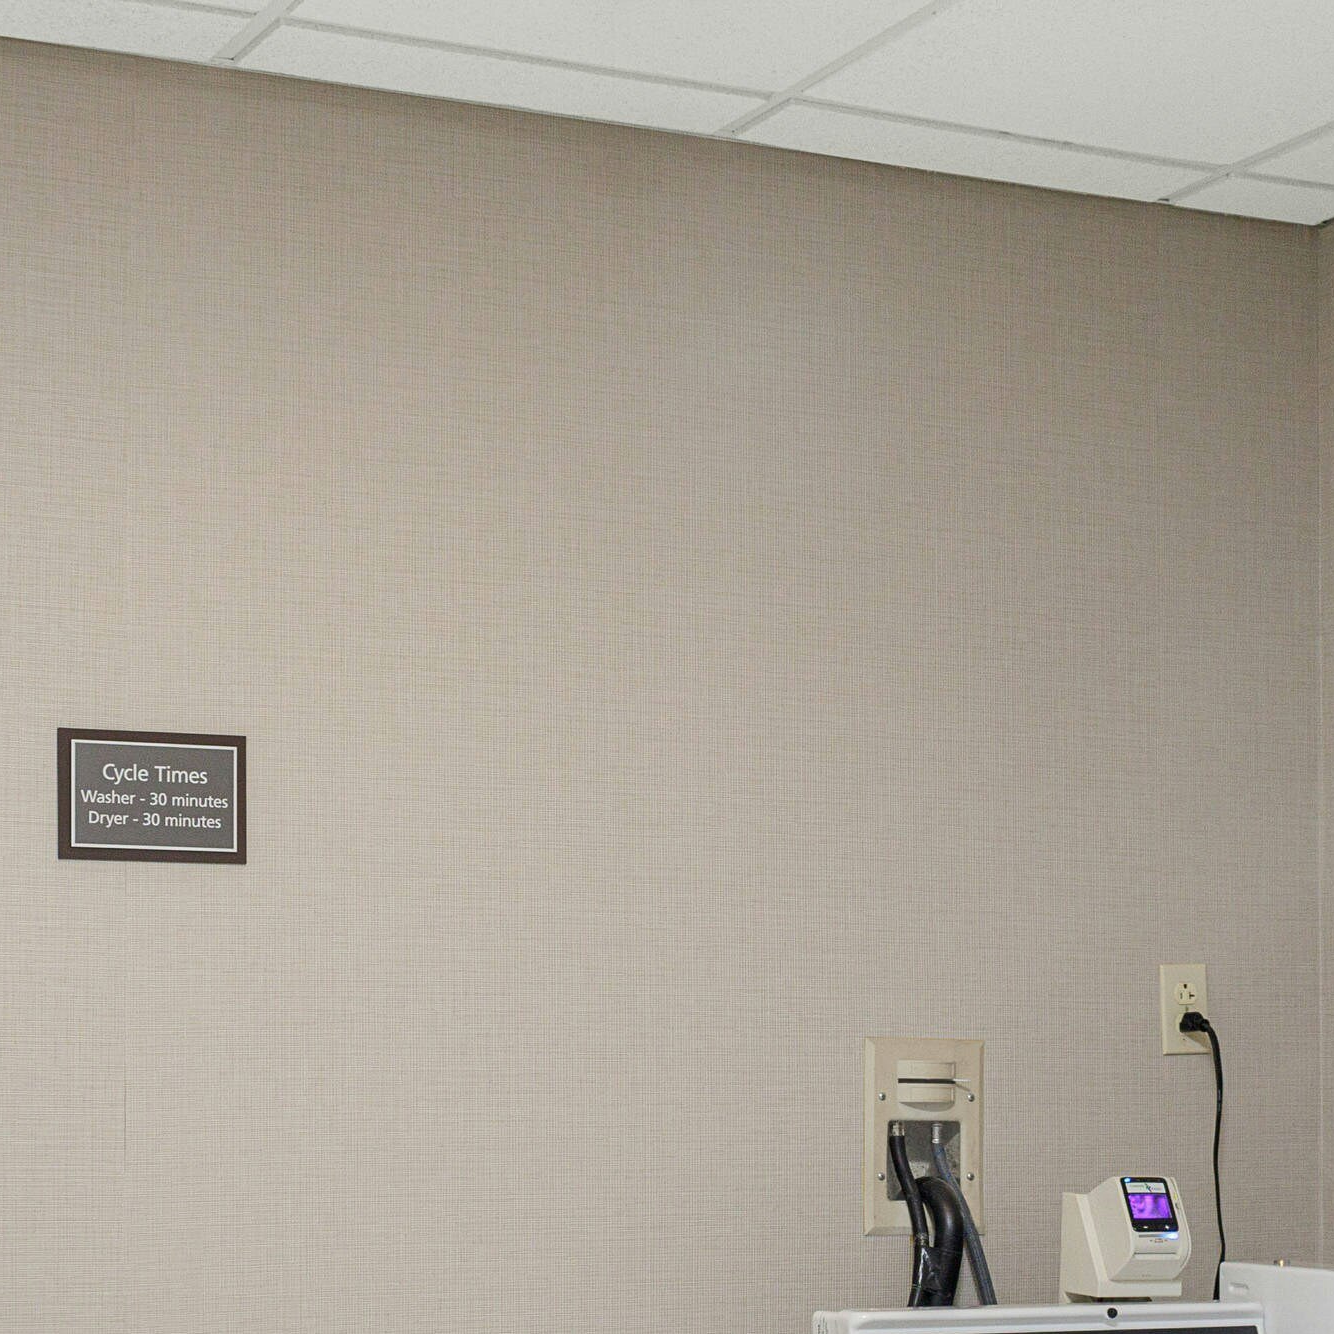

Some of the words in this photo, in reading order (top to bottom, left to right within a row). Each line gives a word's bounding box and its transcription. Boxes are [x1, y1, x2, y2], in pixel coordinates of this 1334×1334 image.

[102, 763, 149, 784] Cycle
[154, 766, 208, 784] Times
[81, 789, 136, 805] Washer
[150, 793, 166, 806] 30
[172, 794, 228, 808] minutes
[88, 811, 129, 828] Dryer
[142, 813, 160, 826] 30
[165, 814, 221, 829] minutes
